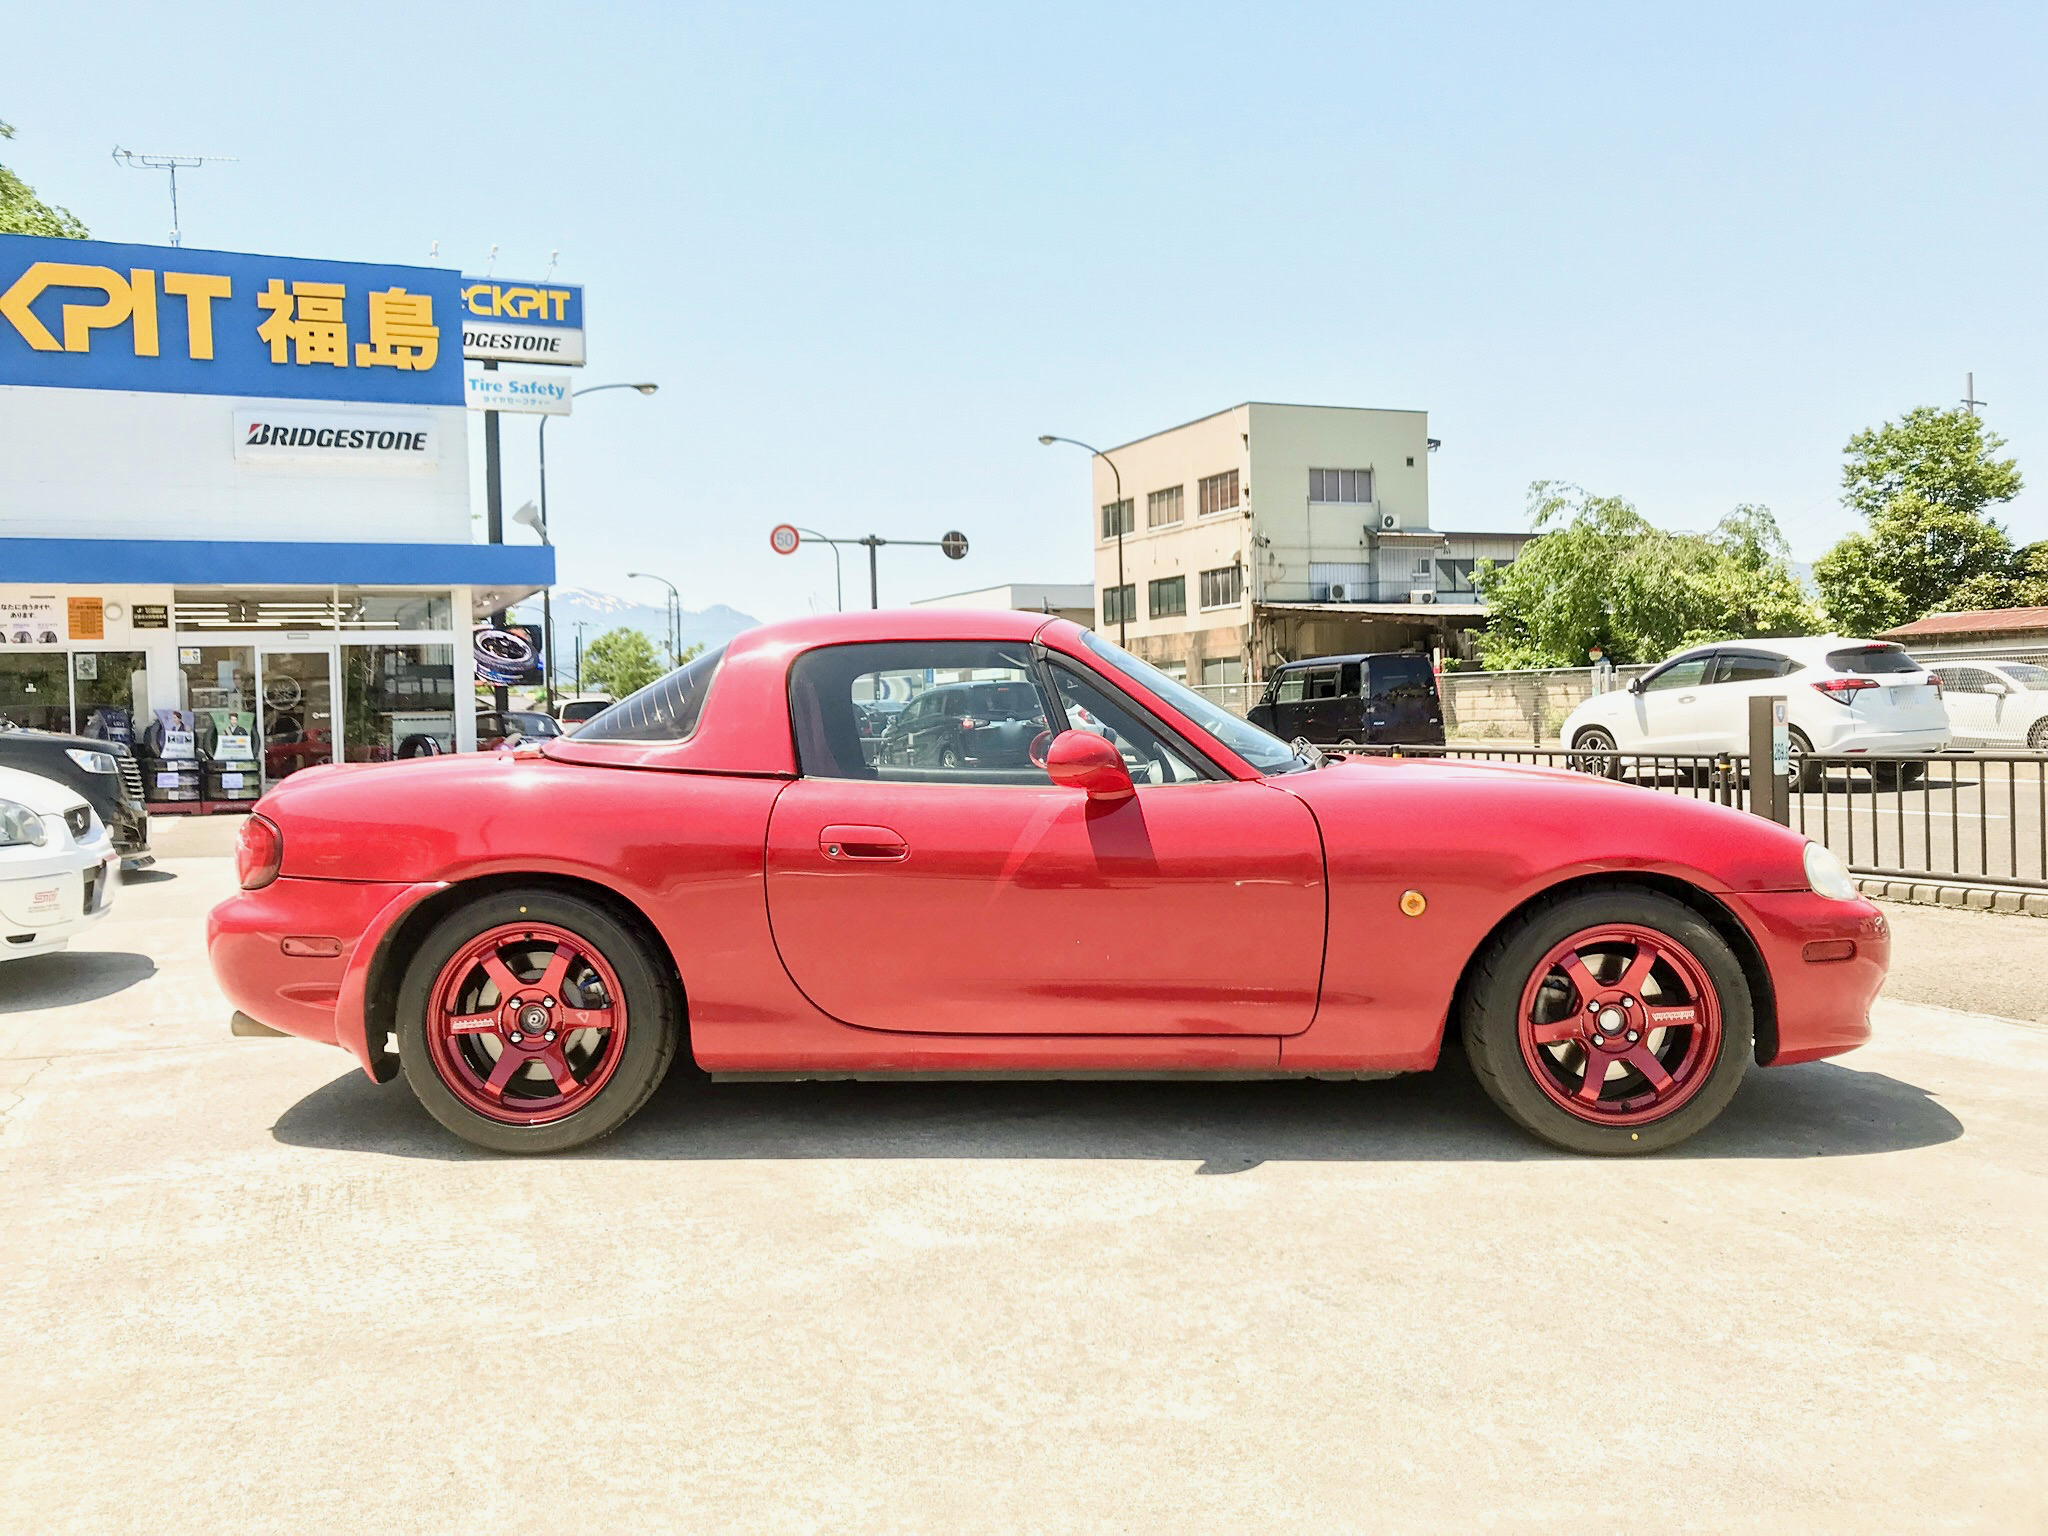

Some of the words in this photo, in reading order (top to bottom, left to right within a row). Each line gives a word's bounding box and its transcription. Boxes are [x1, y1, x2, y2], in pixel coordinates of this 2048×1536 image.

[461, 285, 571, 320] CKPIT
[257, 279, 440, 371] 福島
[468, 378, 503, 393] Tire
[508, 381, 565, 400] Safety
[246, 424, 428, 451] BRIDGESTONE
[776, 532, 794, 547] 50
